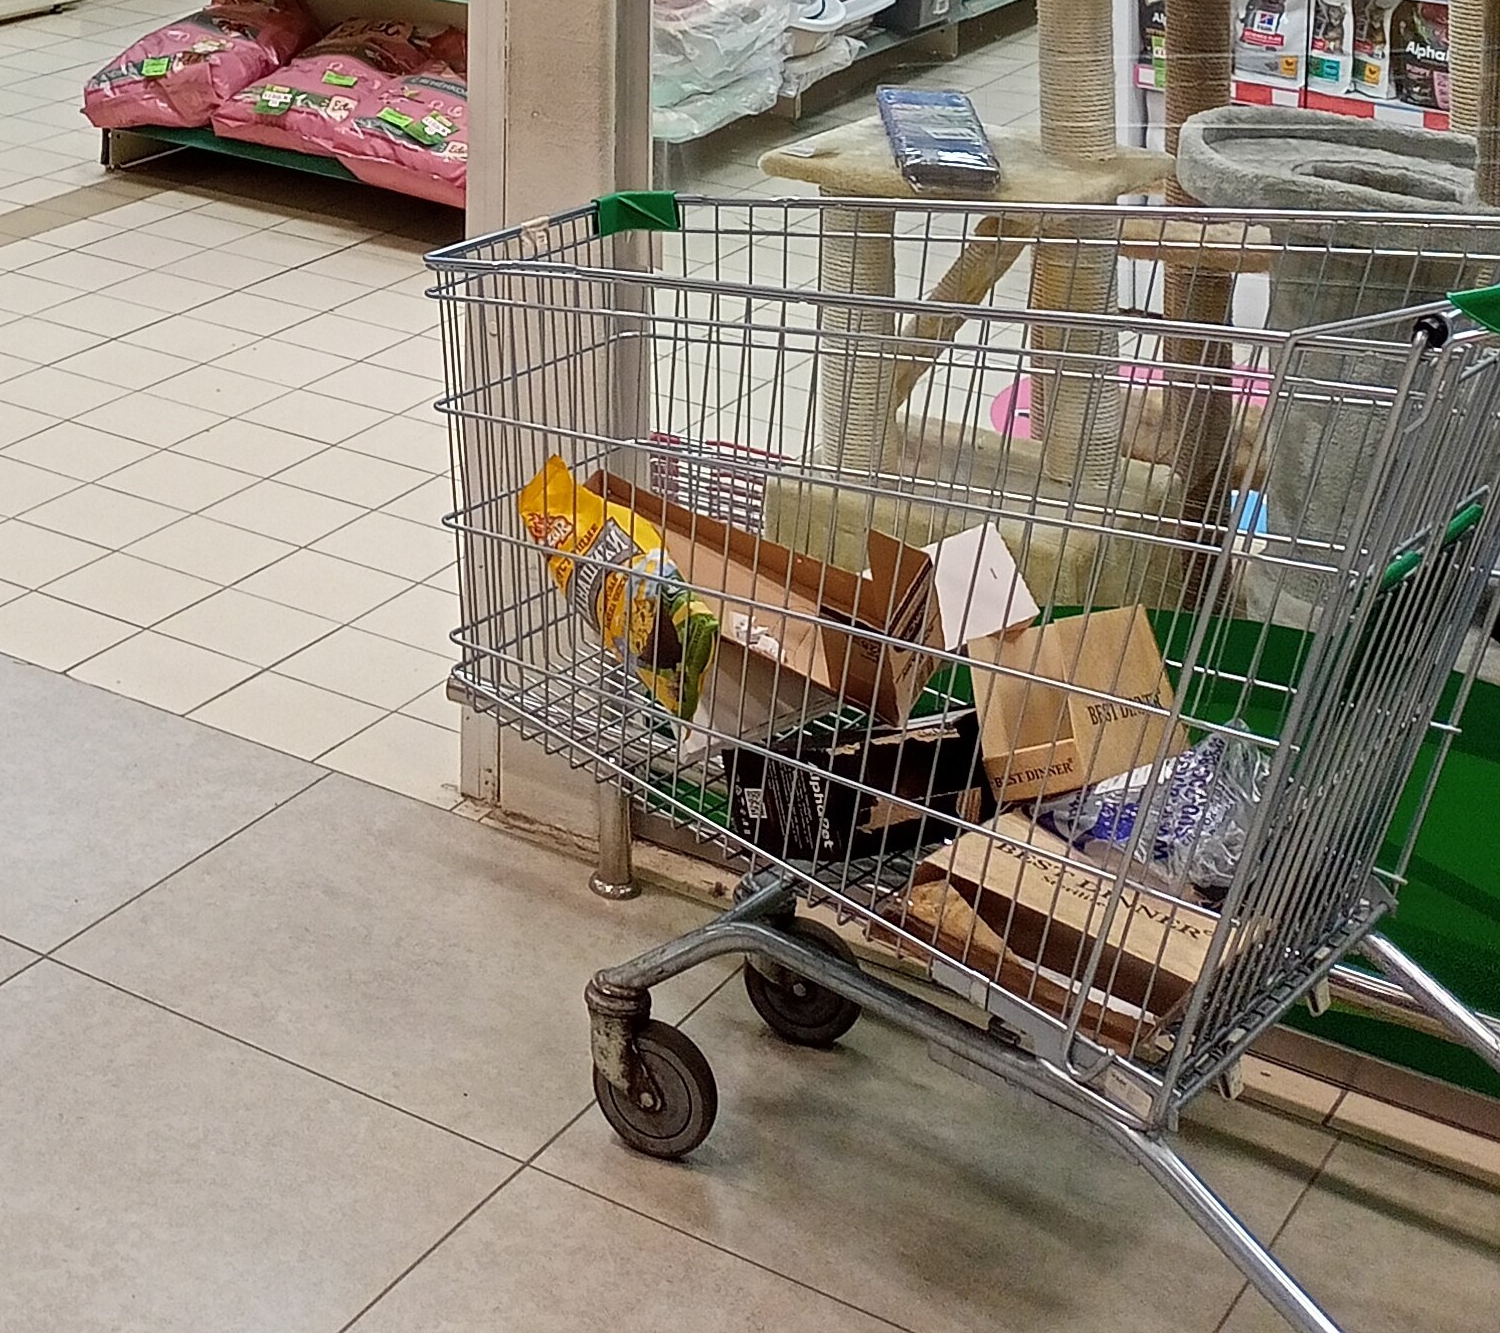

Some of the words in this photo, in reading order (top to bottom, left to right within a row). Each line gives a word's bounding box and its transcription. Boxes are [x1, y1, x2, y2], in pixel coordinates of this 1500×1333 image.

[1087, 703, 1118, 725] BEST
[994, 773, 1024, 789] BEST
[995, 841, 1073, 880] BEST
